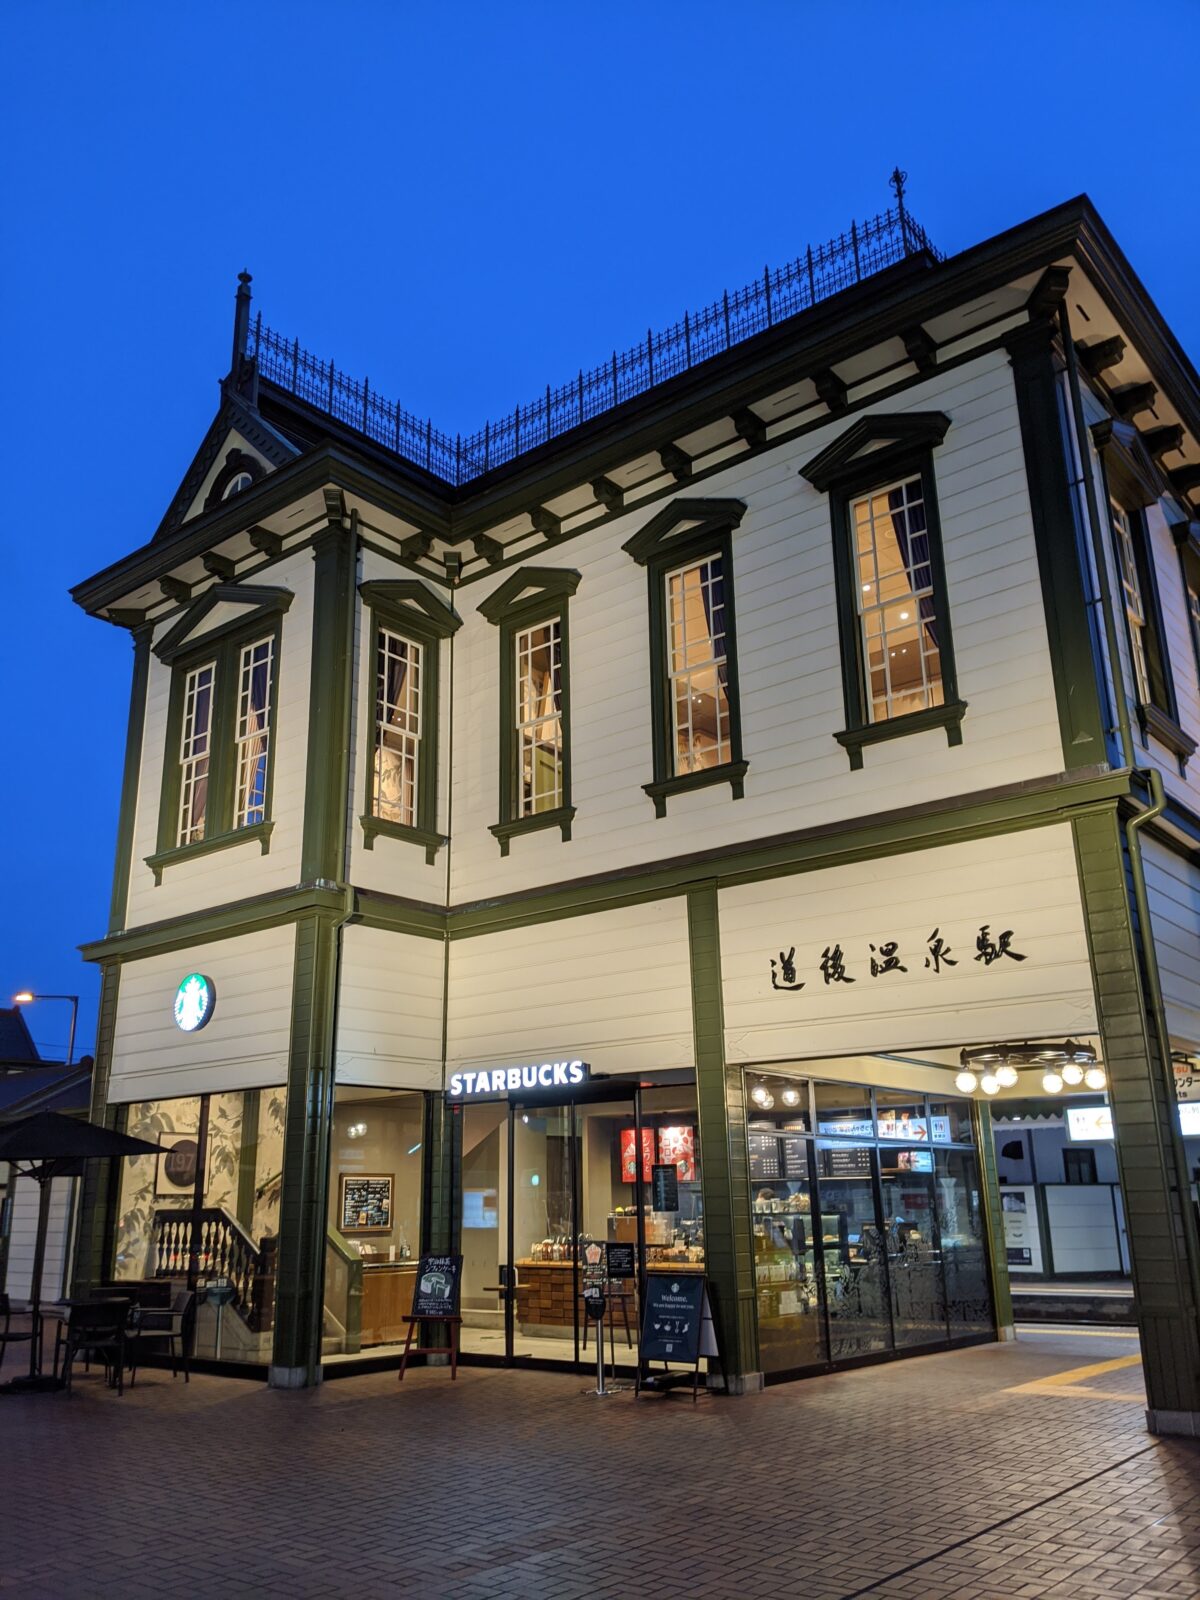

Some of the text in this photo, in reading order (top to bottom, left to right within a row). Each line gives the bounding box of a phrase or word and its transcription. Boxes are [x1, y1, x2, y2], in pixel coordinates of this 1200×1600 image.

[769, 925, 1028, 991] 道後温泉駅
[450, 1060, 584, 1096] STARBUCKS
[165, 1153, 195, 1172] 197
